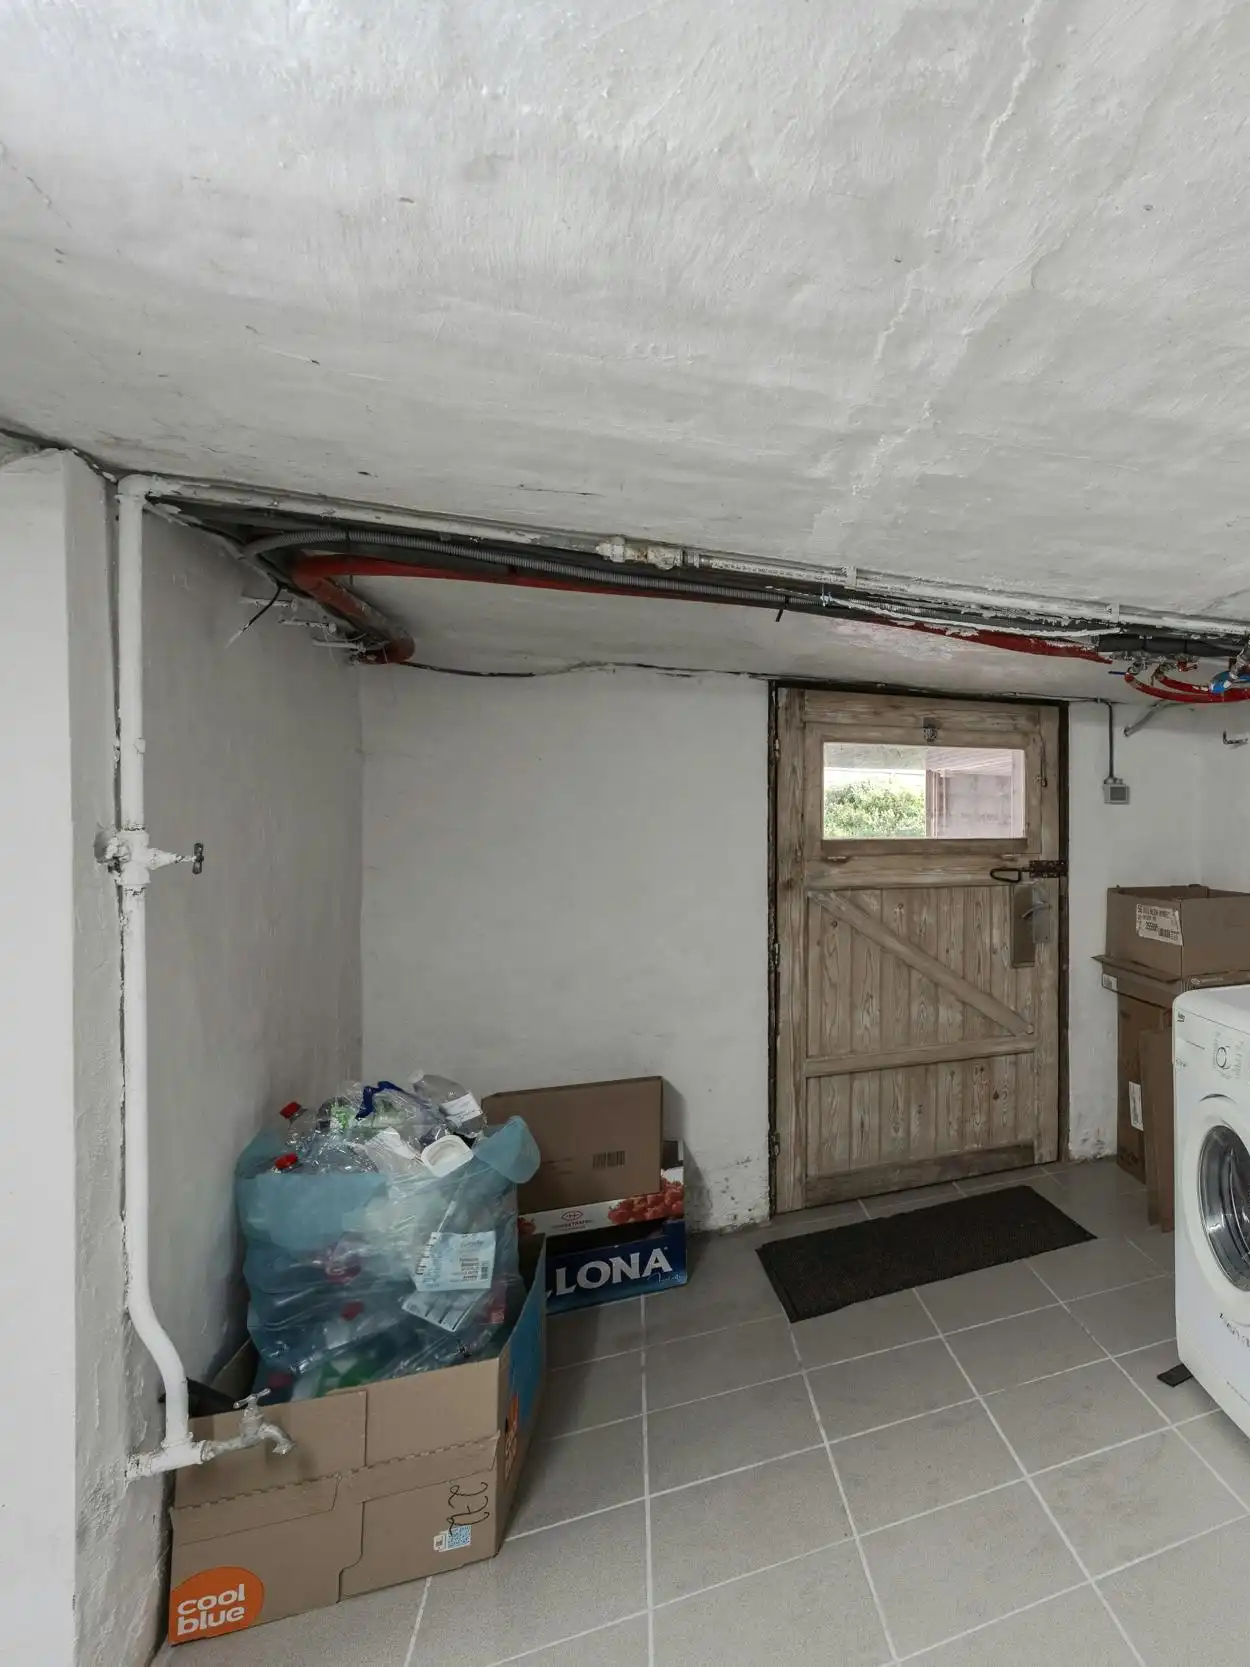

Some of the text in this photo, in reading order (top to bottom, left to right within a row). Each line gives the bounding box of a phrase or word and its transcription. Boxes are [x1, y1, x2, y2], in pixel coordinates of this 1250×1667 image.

[547, 1247, 673, 1297] LONA
[177, 1583, 246, 1615] cool
[177, 1606, 245, 1636] blue
